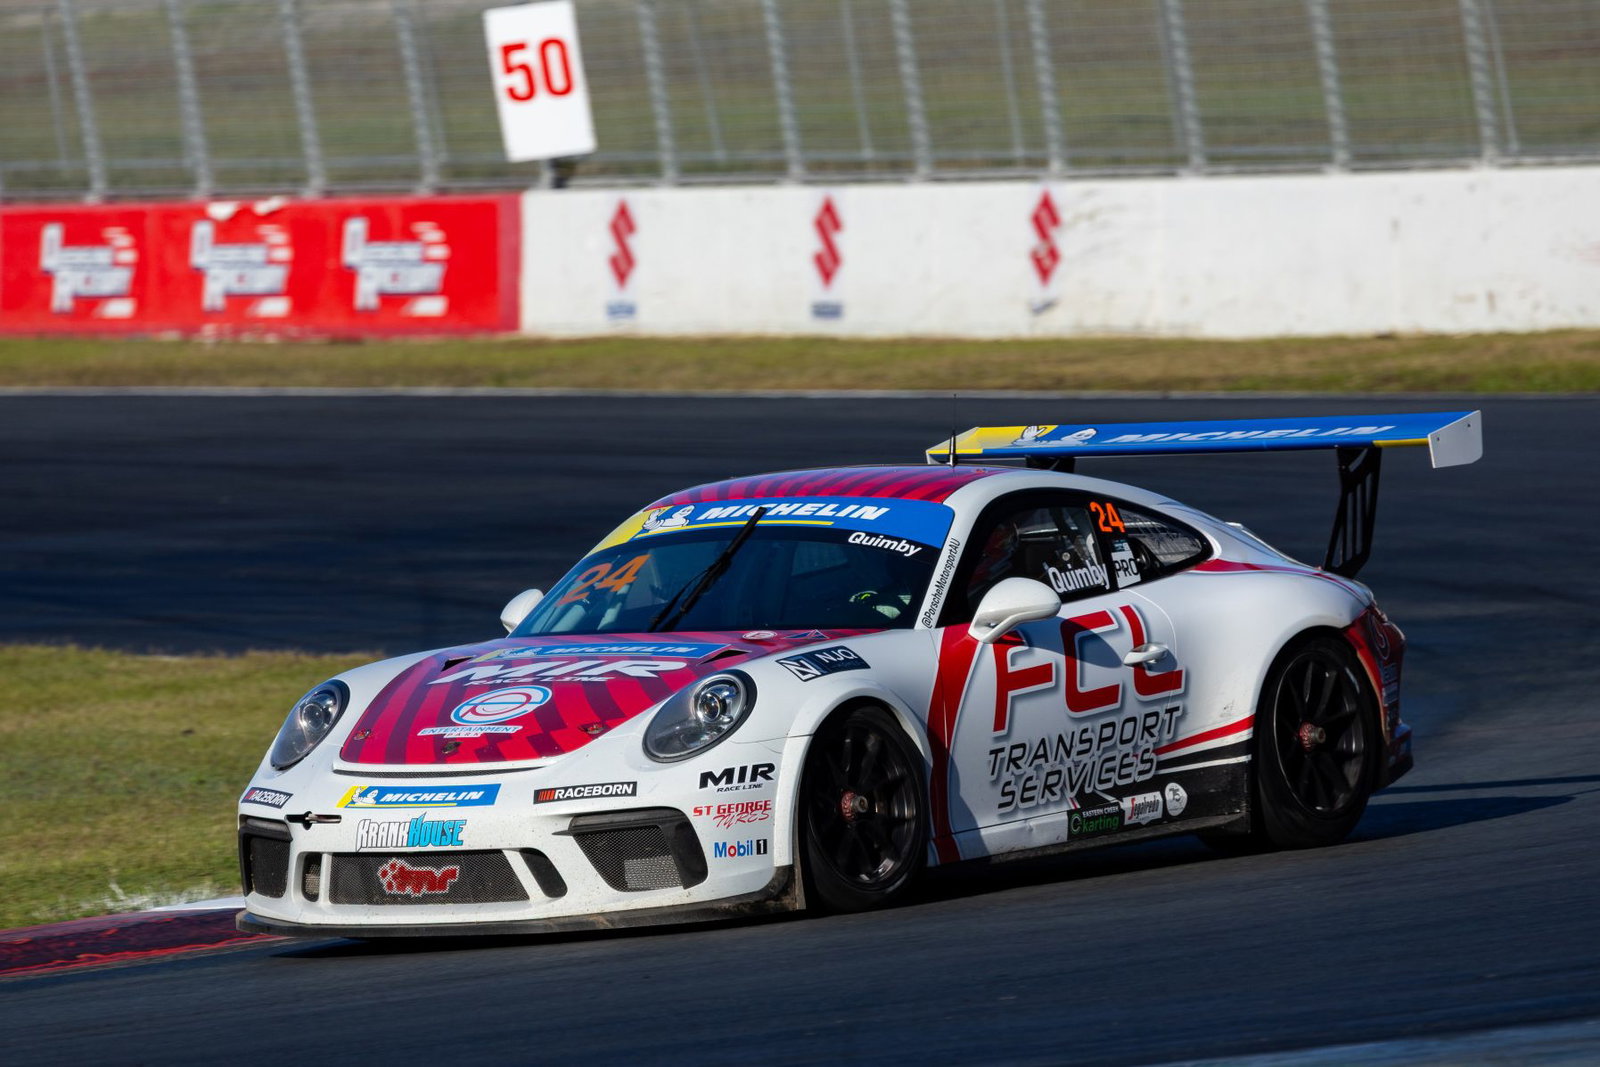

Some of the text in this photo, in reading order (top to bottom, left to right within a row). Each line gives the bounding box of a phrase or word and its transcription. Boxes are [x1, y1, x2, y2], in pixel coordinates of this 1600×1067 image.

[501, 38, 574, 102] 50
[1101, 425, 1397, 444] MICHELIN
[695, 503, 890, 521] MICHELIN
[1090, 501, 1126, 533] 24
[848, 531, 922, 557] Quimby
[1049, 561, 1109, 594] Quimby
[1114, 558, 1140, 579] PRO
[554, 553, 653, 608] 24
[922, 537, 961, 629] @PorscheMotorsportAU
[546, 646, 699, 655] MICHELIN
[427, 660, 688, 685] MIR
[992, 604, 1184, 732] FCL
[463, 676, 536, 686] RACE
[420, 726, 519, 735] ENTERTAINMENT
[989, 705, 1181, 776] TRANSPORT
[699, 763, 775, 789] MIR
[997, 748, 1156, 810] SERVICES
[379, 791, 485, 802] MICHELIN
[555, 783, 634, 799] RACEBORN
[717, 785, 740, 793] RACE
[693, 800, 772, 817] ST GEORGE
[1082, 805, 1119, 818] EASTERN CREEK
[713, 809, 770, 830] TYRES
[1082, 814, 1120, 833] karting
[714, 839, 766, 858] Mobil 1
